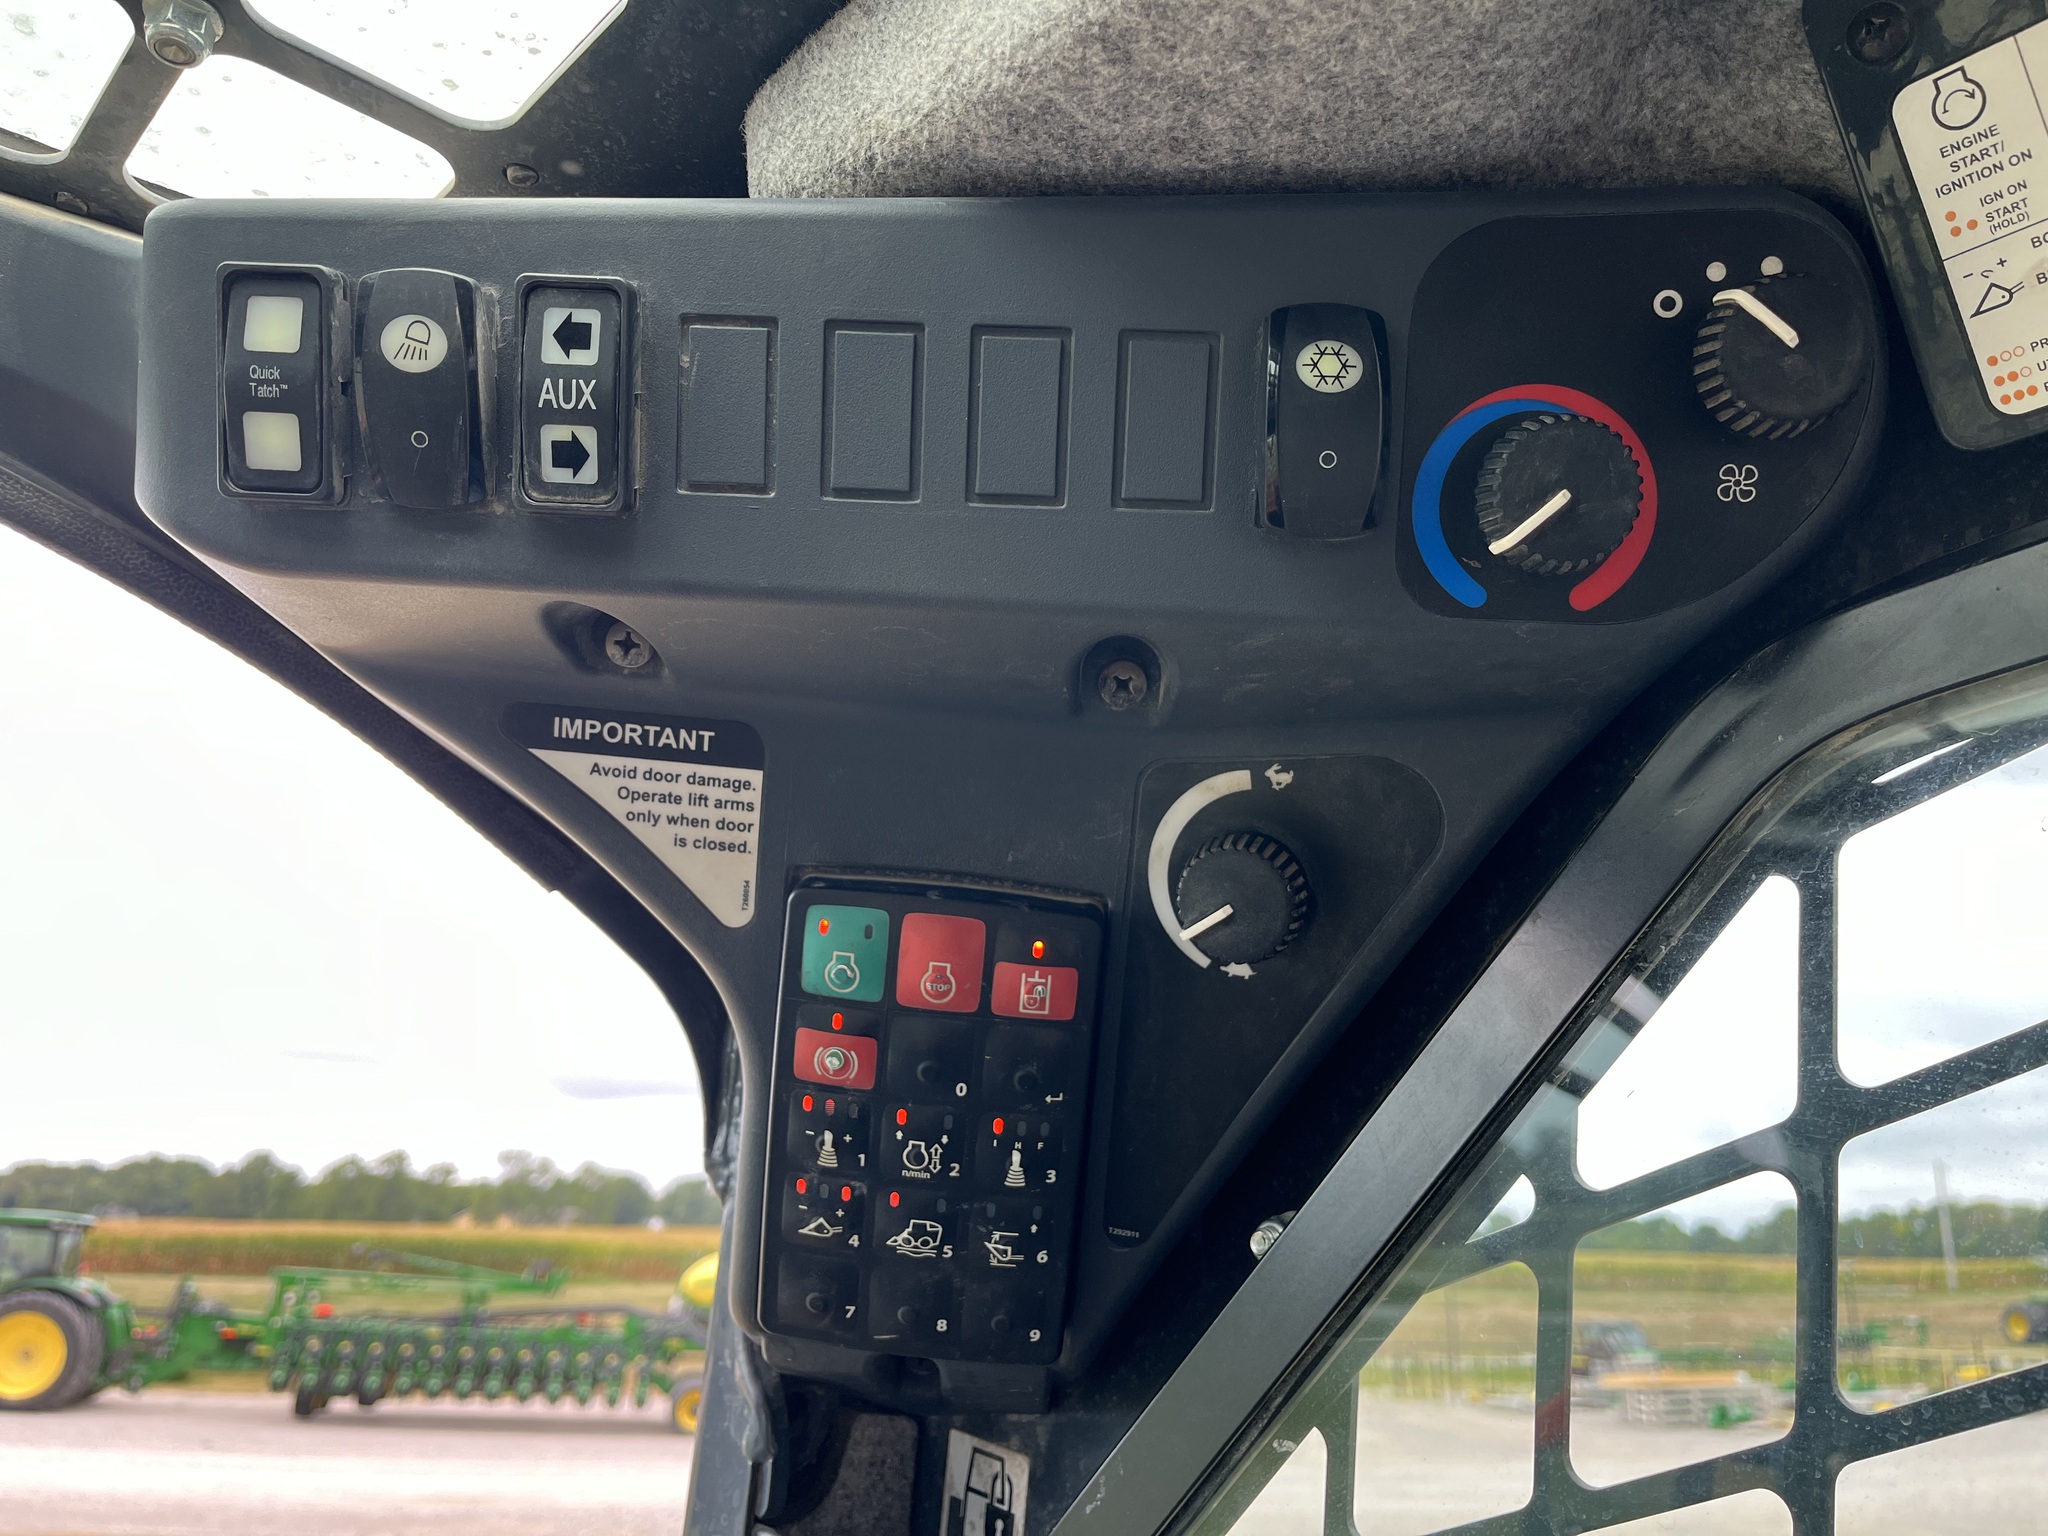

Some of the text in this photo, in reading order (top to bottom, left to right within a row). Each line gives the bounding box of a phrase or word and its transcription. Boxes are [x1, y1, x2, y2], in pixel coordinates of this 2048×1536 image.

[1939, 124, 2001, 159] ENGINE
[1950, 140, 2005, 173] START/
[1935, 148, 2033, 198] IGNITION ON
[1979, 179, 2028, 207] IGN ON
[1985, 197, 2028, 223] START
[1989, 210, 2030, 236] (HOLD)
[249, 364, 281, 380] Quick
[538, 378, 597, 411] AUX
[553, 716, 716, 752] IMPORTANT
[589, 762, 757, 793] Avoid door damage.
[617, 786, 755, 813] Operate lift arms
[626, 810, 755, 833] only when door
[673, 833, 752, 854] is closed.
[925, 982, 951, 992] STOP
[1014, 1141, 1022, 1150] H
[1037, 1142, 1044, 1150] F
[857, 1153, 866, 1167] 1
[901, 1169, 931, 1179] n/min
[948, 1163, 961, 1177] 2
[1045, 1169, 1057, 1183] 3
[848, 1234, 860, 1248] 4
[942, 1246, 953, 1258] 5
[1036, 1250, 1048, 1263] 6
[845, 1305, 856, 1318] 7
[936, 1319, 948, 1332] 8
[1029, 1329, 1041, 1342] 9
